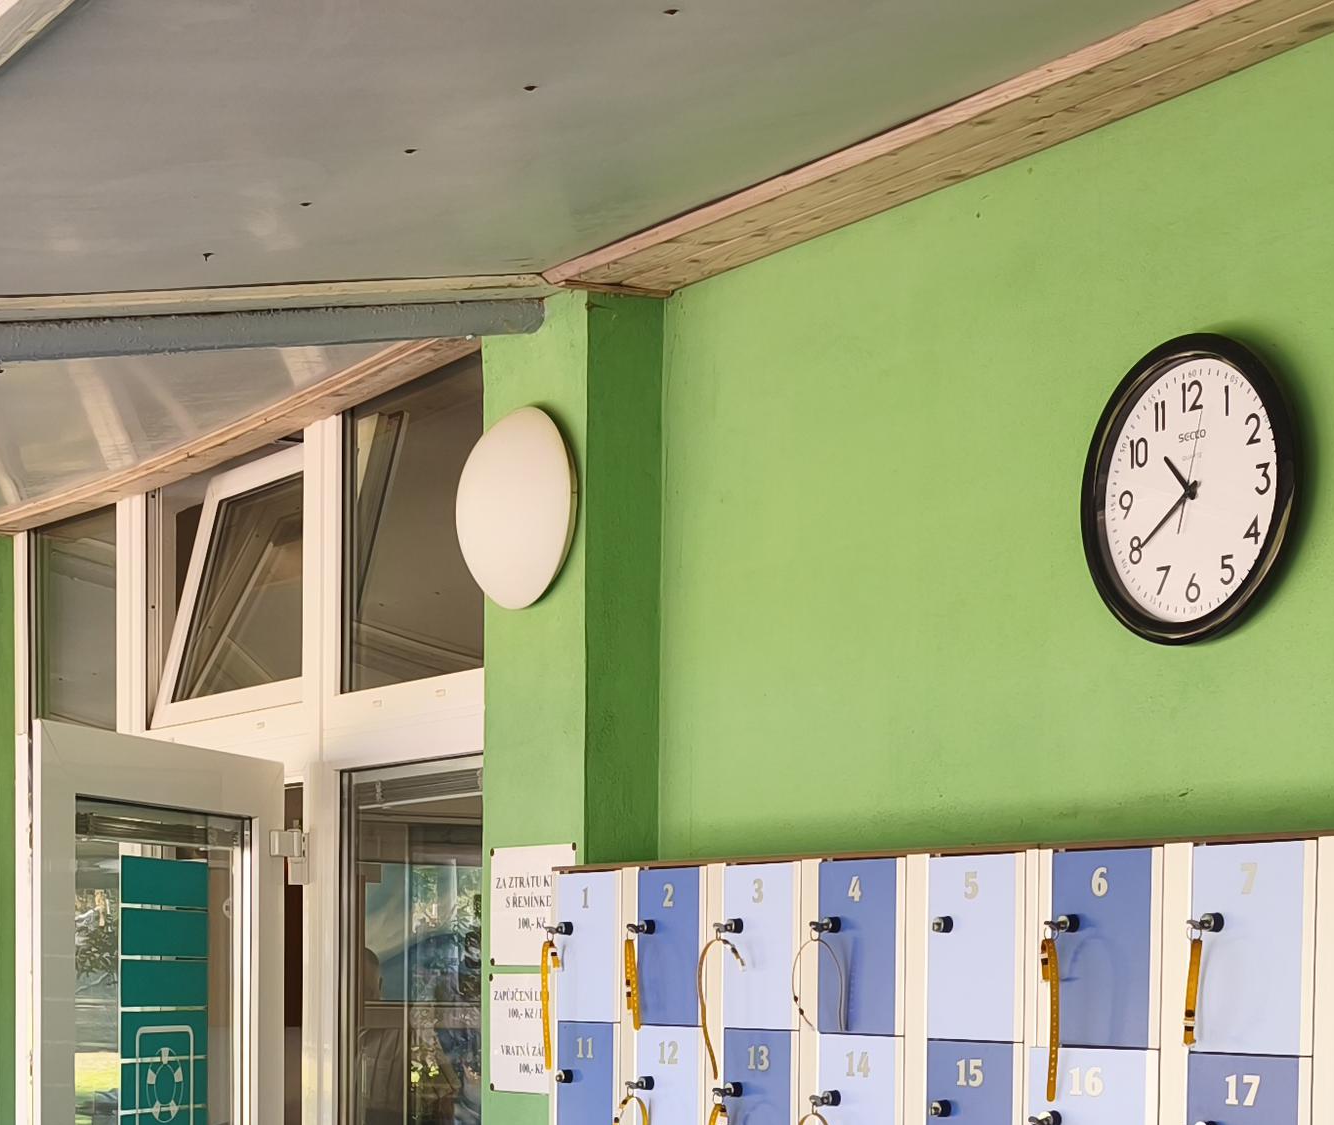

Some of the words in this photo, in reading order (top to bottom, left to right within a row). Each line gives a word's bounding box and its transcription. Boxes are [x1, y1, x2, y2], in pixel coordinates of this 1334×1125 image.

[1181, 380, 1203, 413] 12
[1224, 385, 1229, 416] 1
[1154, 400, 1166, 432] 11
[1245, 413, 1261, 446] 2
[1130, 437, 1148, 469] 10
[1255, 462, 1271, 495] 3
[1119, 490, 1133, 520] 9
[1243, 514, 1260, 544] 4
[1129, 536, 1142, 565] 8
[1156, 565, 1171, 596] 7
[1220, 554, 1235, 585] 5
[1185, 572, 1201, 603] 6
[495, 877, 506, 889] ZA
[508, 873, 541, 888] ZTRÁTU
[752, 878, 764, 903] 3
[848, 875, 862, 902] 4
[964, 871, 979, 900] 5
[1091, 866, 1108, 897] 6
[1240, 862, 1258, 895] 7
[581, 887, 590, 909] 1
[663, 883, 674, 908] 2
[494, 988, 533, 1001] ZAPŮJČENÍ
[500, 1042, 530, 1056] VRATNÁ
[576, 1037, 595, 1059] 11
[658, 1041, 679, 1065] 12
[747, 1045, 770, 1071] 13
[845, 1051, 871, 1078] 14
[955, 1058, 984, 1088] 15
[1069, 1066, 1104, 1097] 16
[1224, 1074, 1261, 1107] 17
